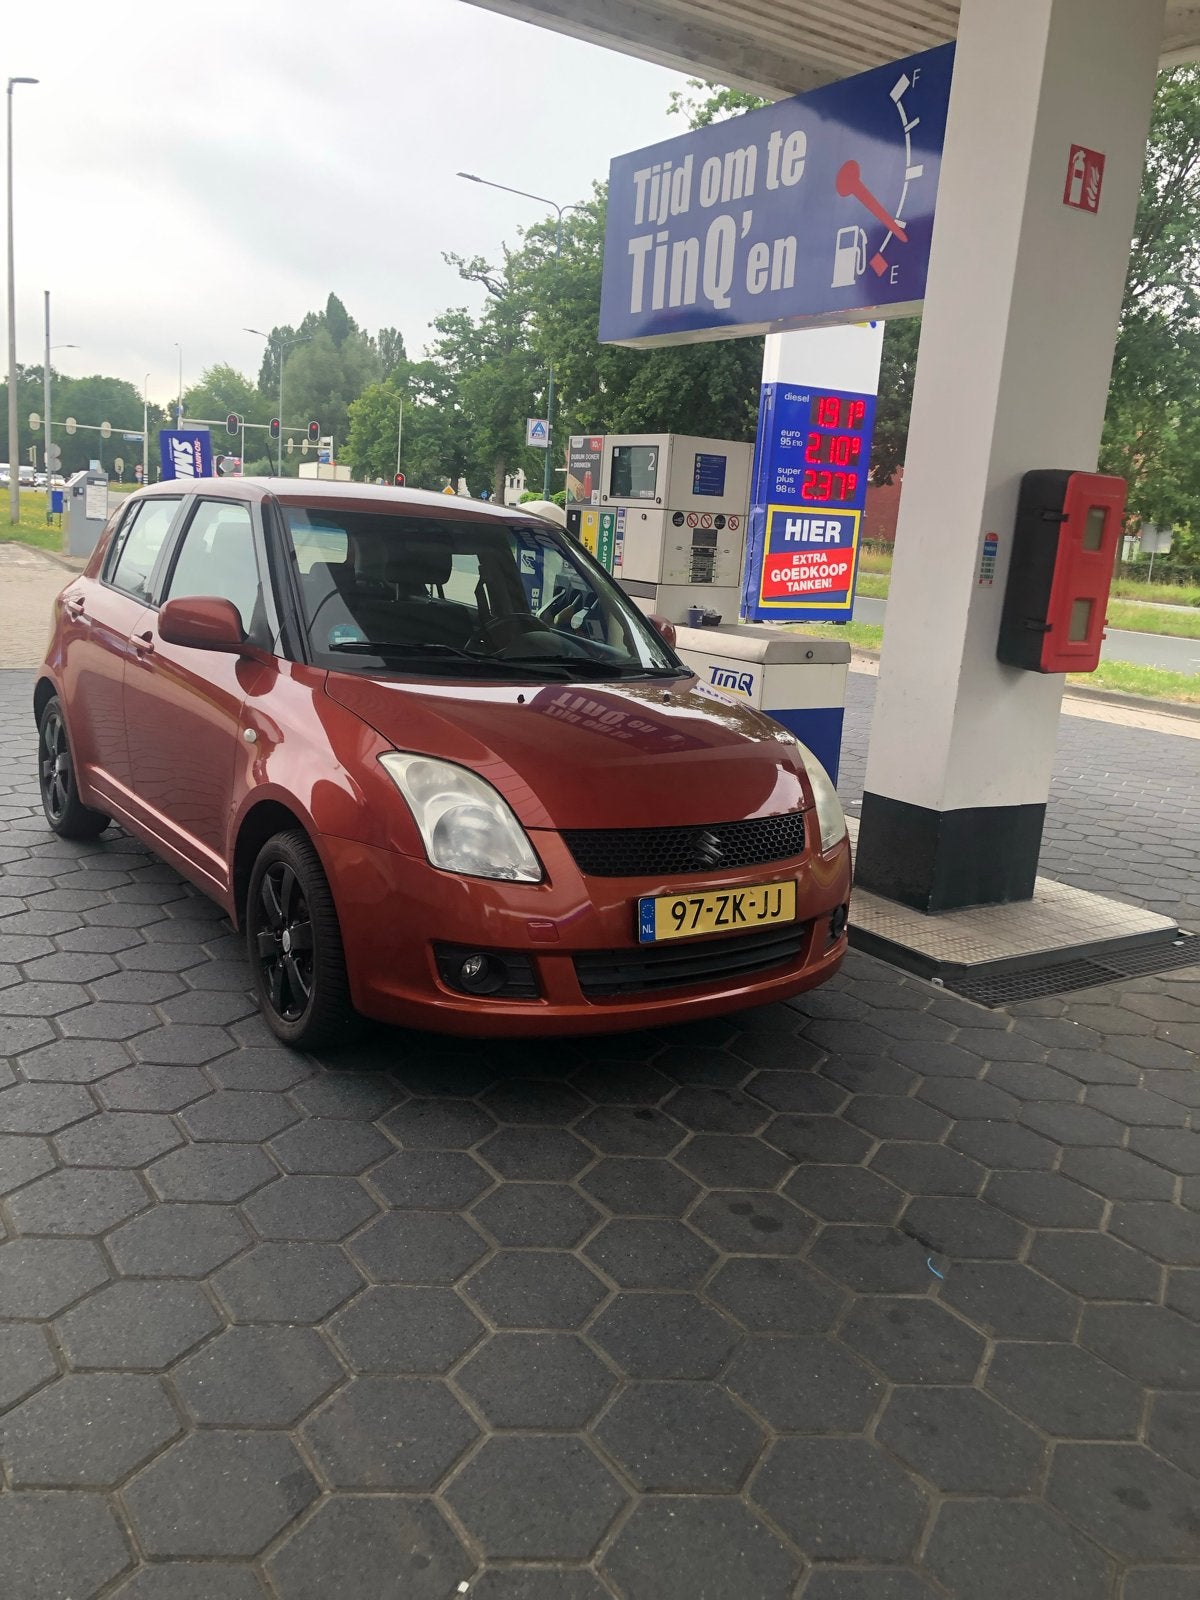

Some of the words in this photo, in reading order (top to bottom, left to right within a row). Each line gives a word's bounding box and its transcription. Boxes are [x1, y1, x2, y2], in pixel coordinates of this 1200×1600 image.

[912, 69, 921, 88] F
[633, 154, 694, 226] Tijd
[699, 144, 759, 209] om
[765, 130, 808, 191] te
[628, 210, 798, 314] TinQ'en
[890, 265, 900, 284] E
[783, 392, 810, 402] diesel
[780, 429, 801, 438] euro
[780, 437, 791, 446] 95
[792, 439, 803, 447] E10
[647, 452, 656, 471] 2
[777, 467, 801, 476] super
[776, 475, 795, 483] plus
[775, 484, 787, 493] 98
[602, 530, 609, 543] 95
[784, 518, 842, 543] HIER
[792, 552, 828, 565] EXTRA
[770, 562, 848, 582] GOEDKOOP
[786, 578, 832, 592] TANKEN!
[708, 665, 754, 697] TinQ
[670, 888, 782, 932] 97-ZK-JJ
[642, 924, 654, 934] NL
